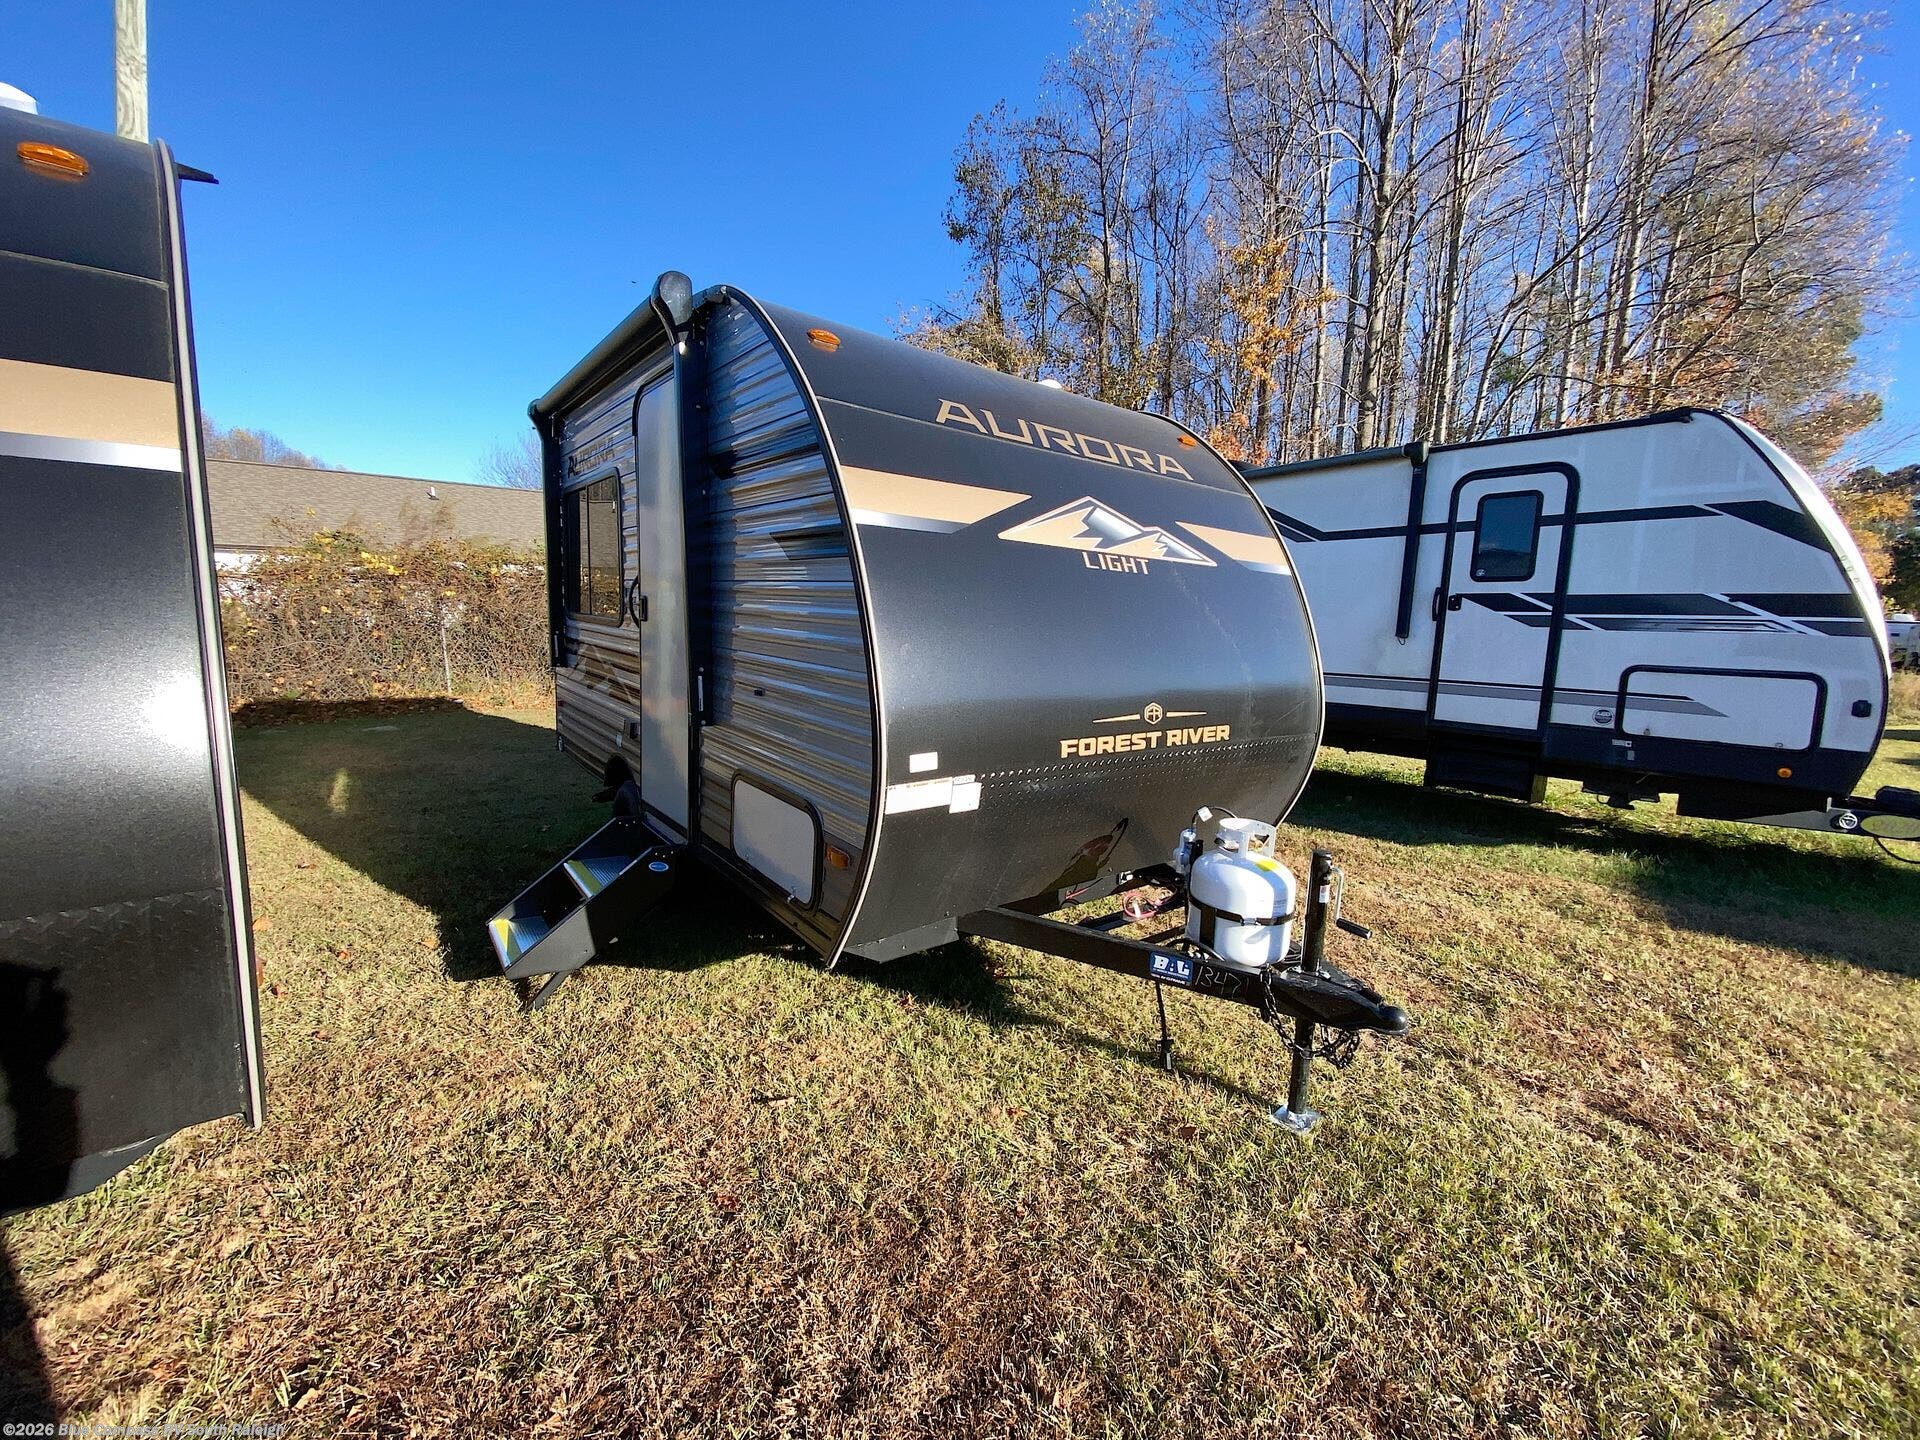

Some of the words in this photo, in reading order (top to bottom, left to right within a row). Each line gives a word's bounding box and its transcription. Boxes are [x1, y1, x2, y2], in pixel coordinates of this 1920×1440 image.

[936, 399, 1193, 480] AURORA
[1082, 551, 1150, 574] LIGHT
[1060, 731, 1162, 758] FOREST
[1166, 724, 1230, 746] RIVER
